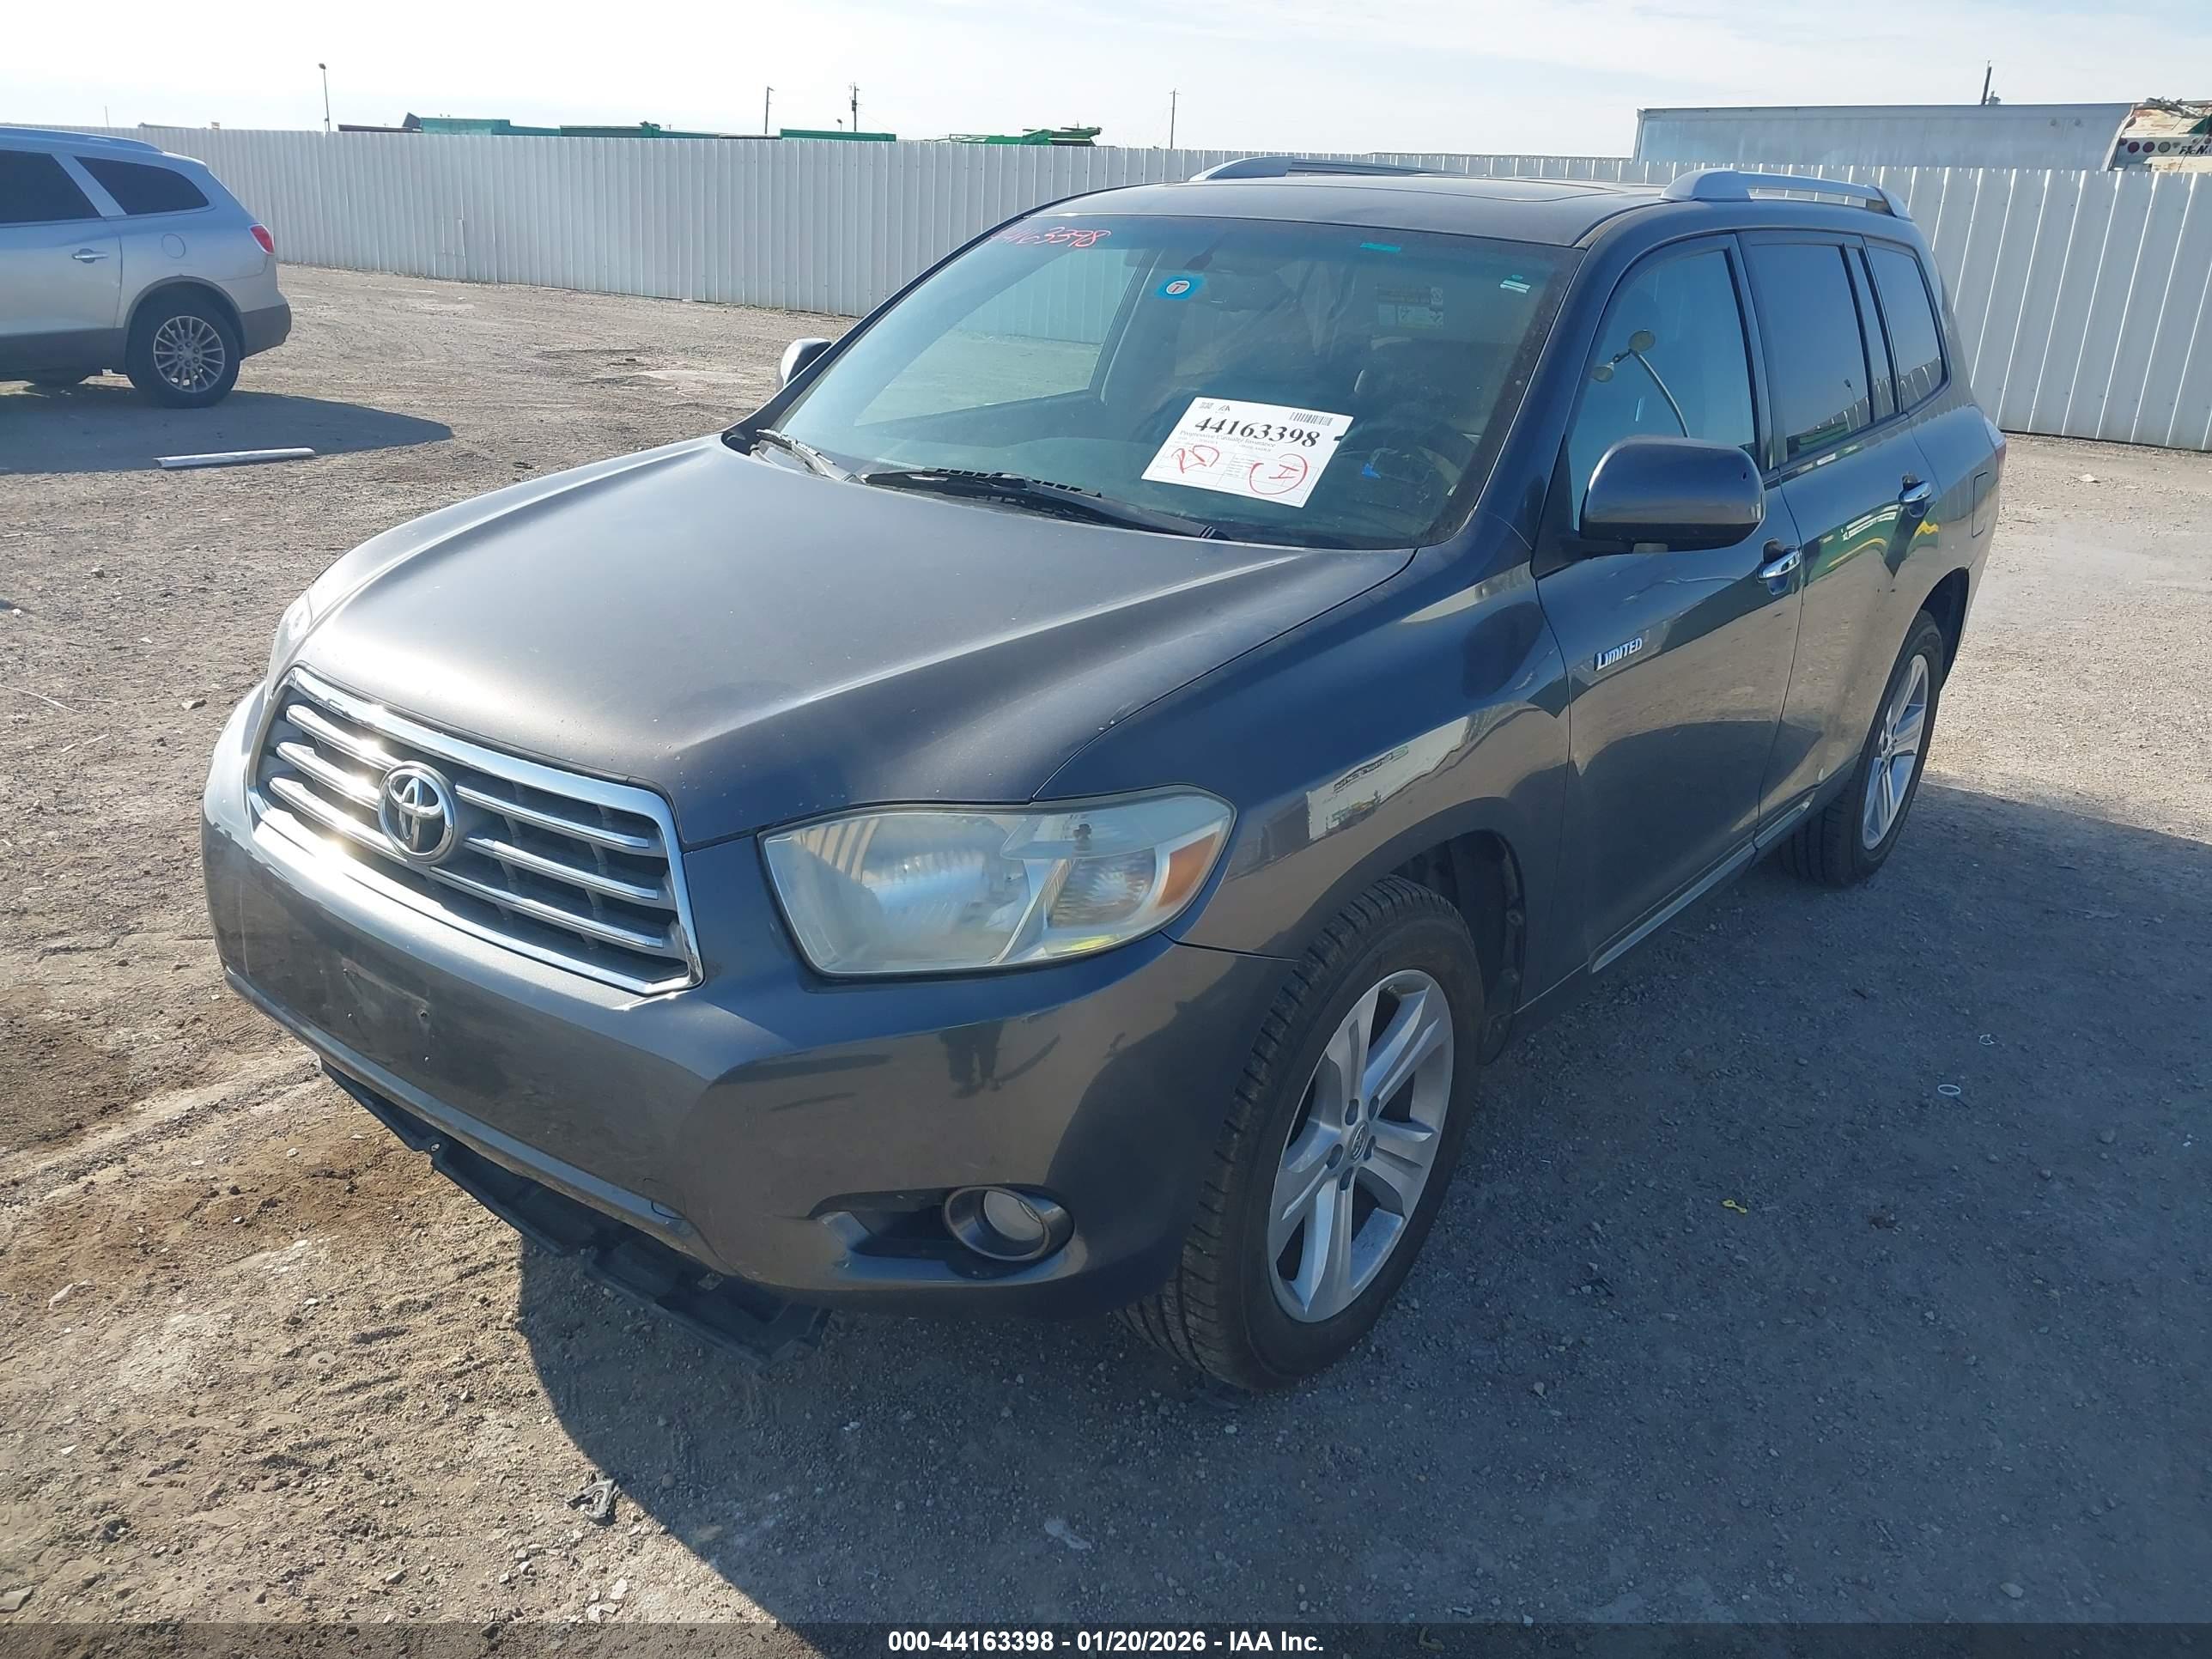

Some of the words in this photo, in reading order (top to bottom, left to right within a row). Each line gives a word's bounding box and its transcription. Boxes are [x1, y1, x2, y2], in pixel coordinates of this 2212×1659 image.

[1180, 429, 1215, 440] Progressive
[1216, 434, 1244, 444] Casualty
[1245, 438, 1277, 448] Insurance
[1195, 417, 1321, 447] 44163398
